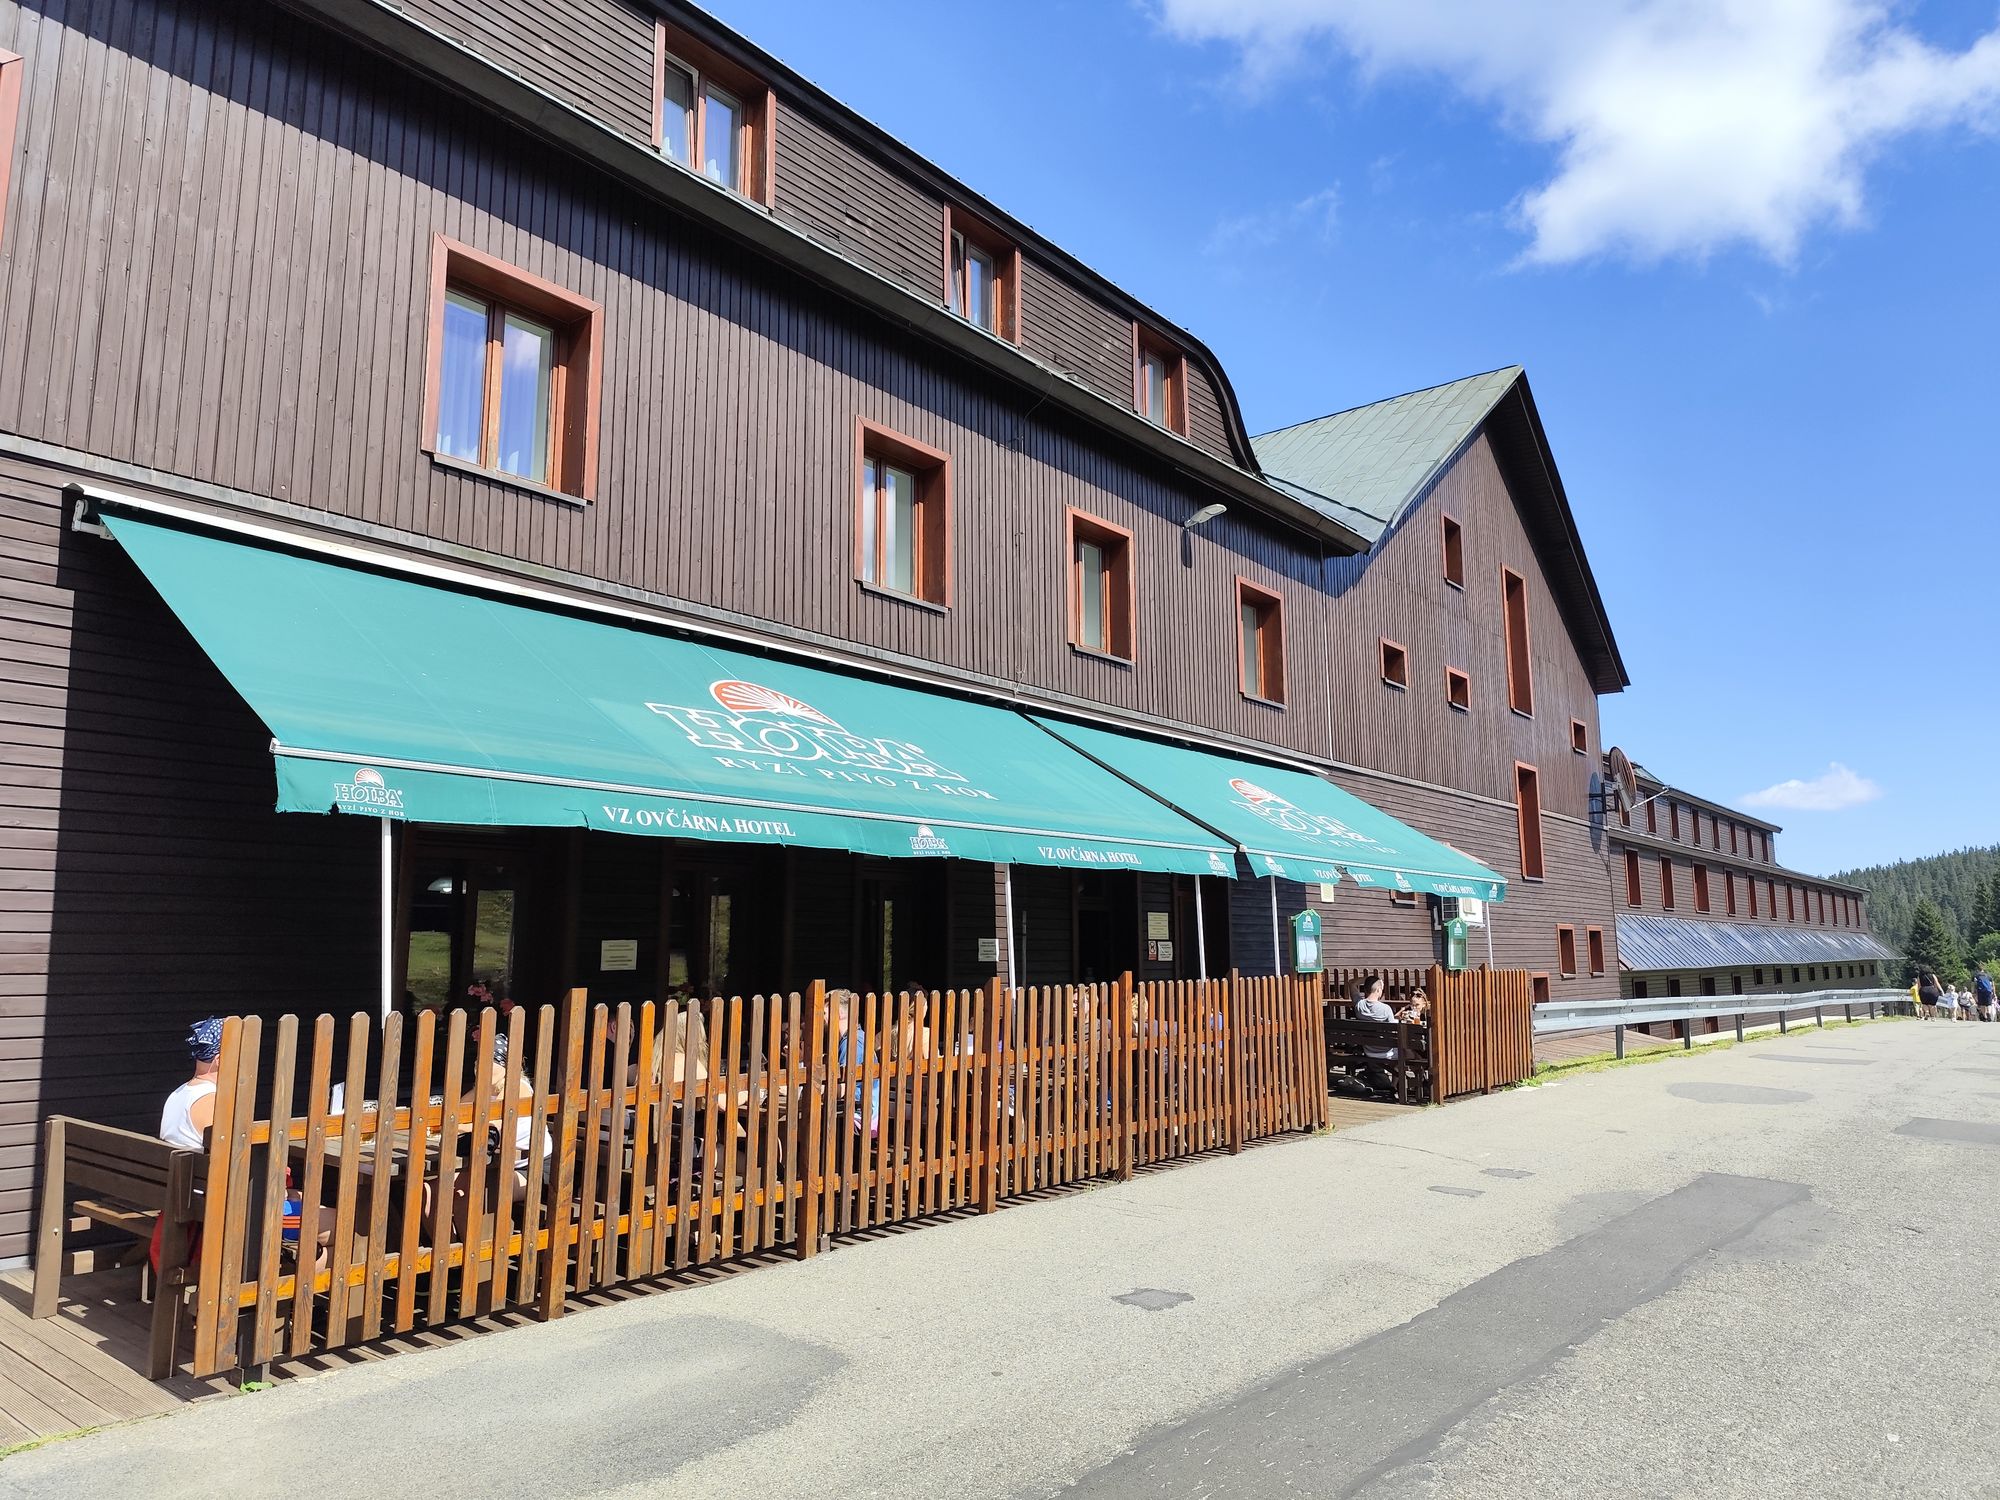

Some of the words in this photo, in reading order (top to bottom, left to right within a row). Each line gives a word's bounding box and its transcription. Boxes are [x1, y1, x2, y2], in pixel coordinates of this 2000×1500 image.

[645, 702, 969, 782] HOLBA
[712, 756, 808, 777] RYZÍ
[815, 767, 896, 787] PIVO
[903, 779, 930, 792] Z
[932, 783, 1000, 801] HOR
[334, 783, 404, 808] HOLBA
[602, 805, 633, 824] VZ
[636, 808, 733, 833] OVČÁRNA
[732, 818, 796, 837] HOTEL
[1037, 846, 1056, 859] VZ
[1056, 846, 1108, 863] OVČÁRNA
[1105, 851, 1142, 864] HOTEL
